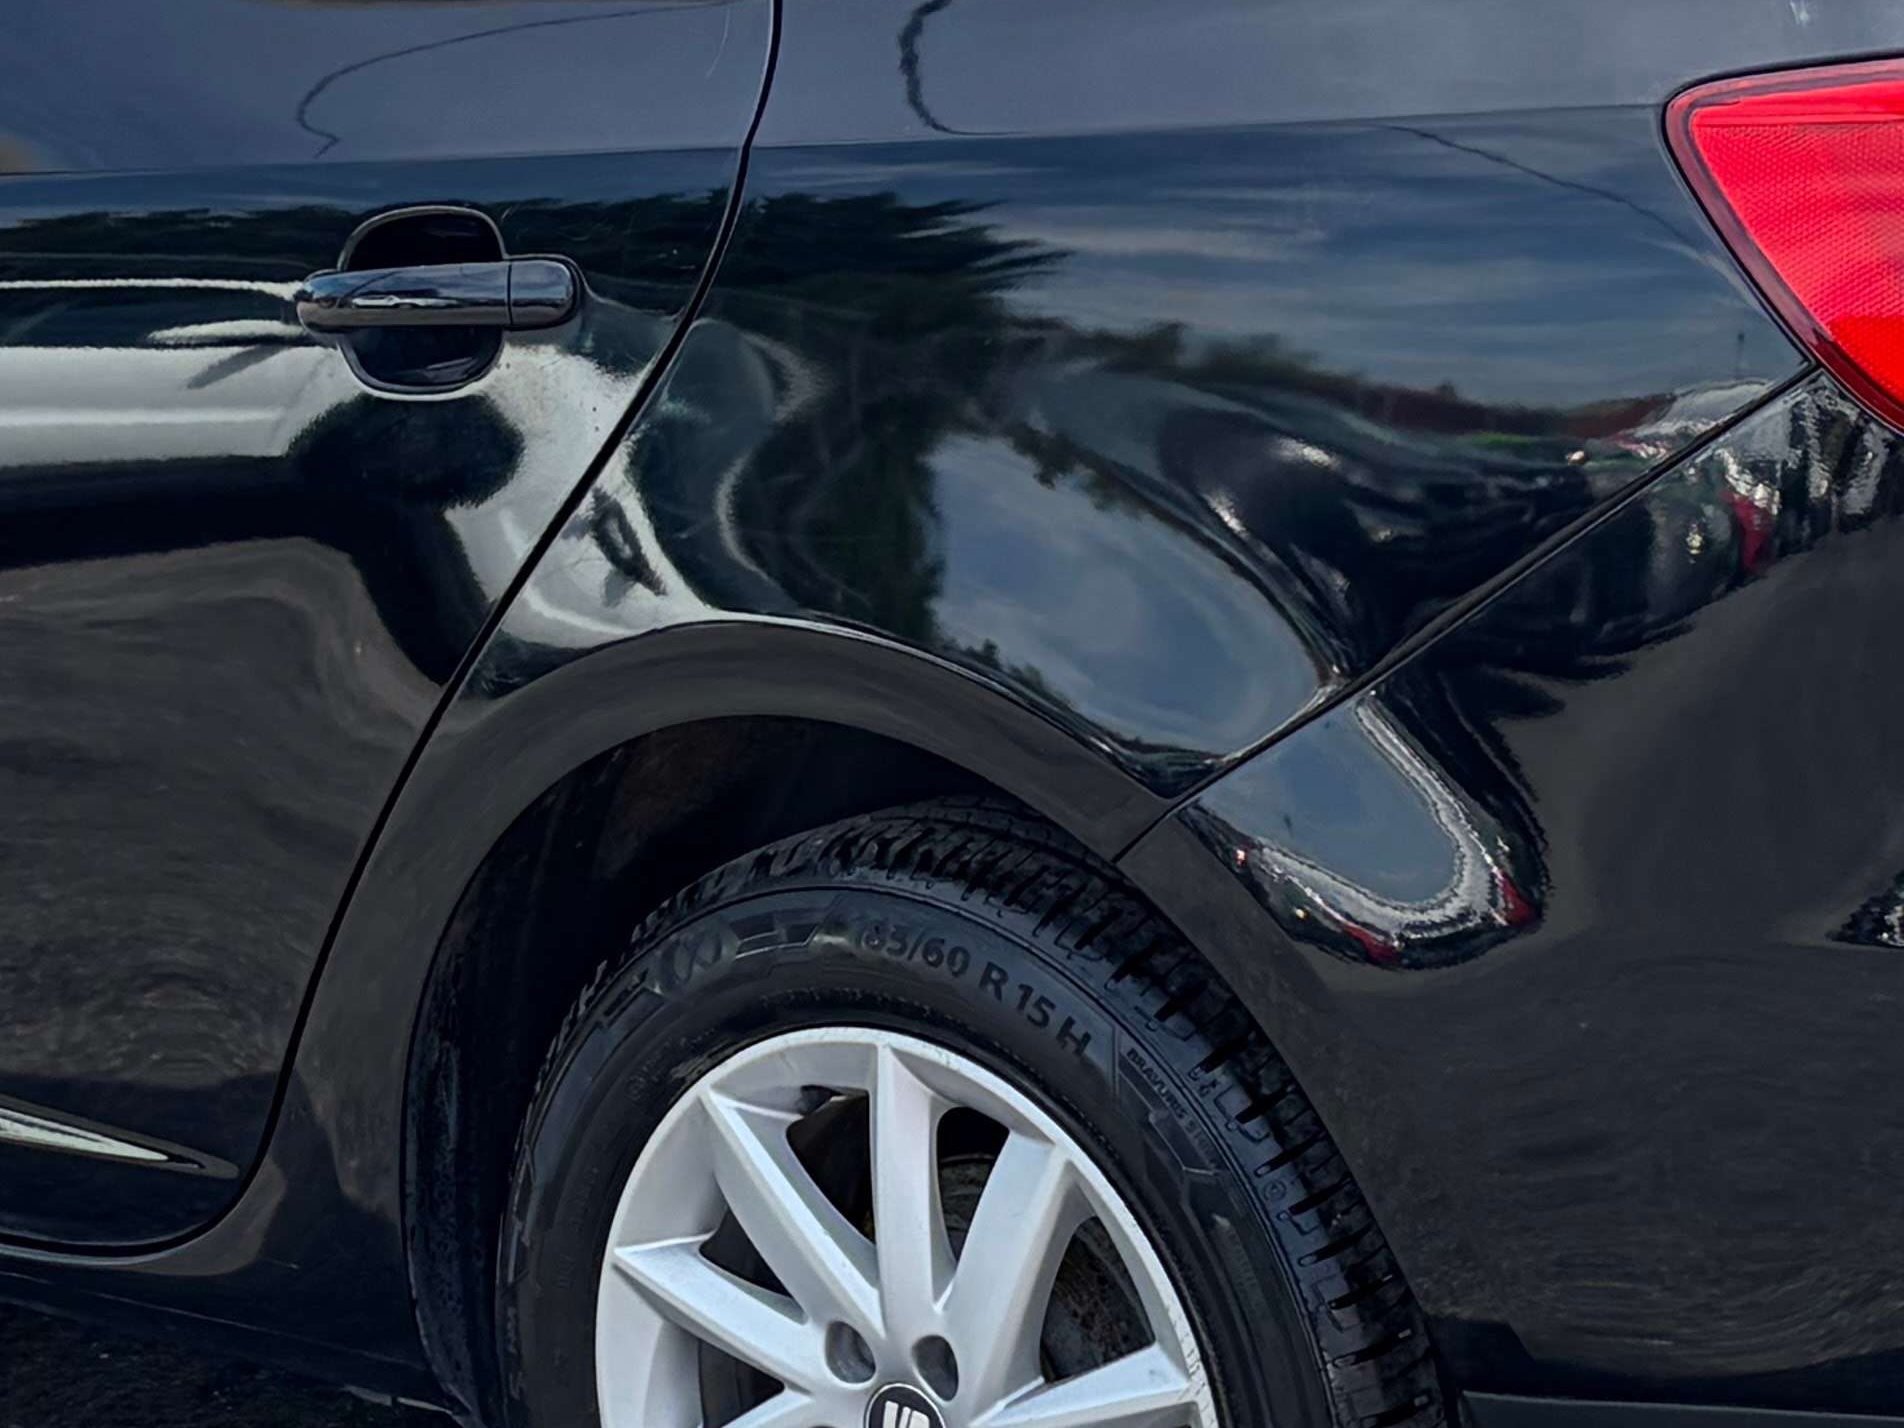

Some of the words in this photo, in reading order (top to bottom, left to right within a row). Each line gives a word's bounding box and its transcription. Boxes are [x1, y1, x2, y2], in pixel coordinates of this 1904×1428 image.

[851, 914, 971, 978] 85/60
[979, 961, 1009, 1002] R
[1016, 983, 1057, 1028] 15
[1056, 1015, 1093, 1057] H
